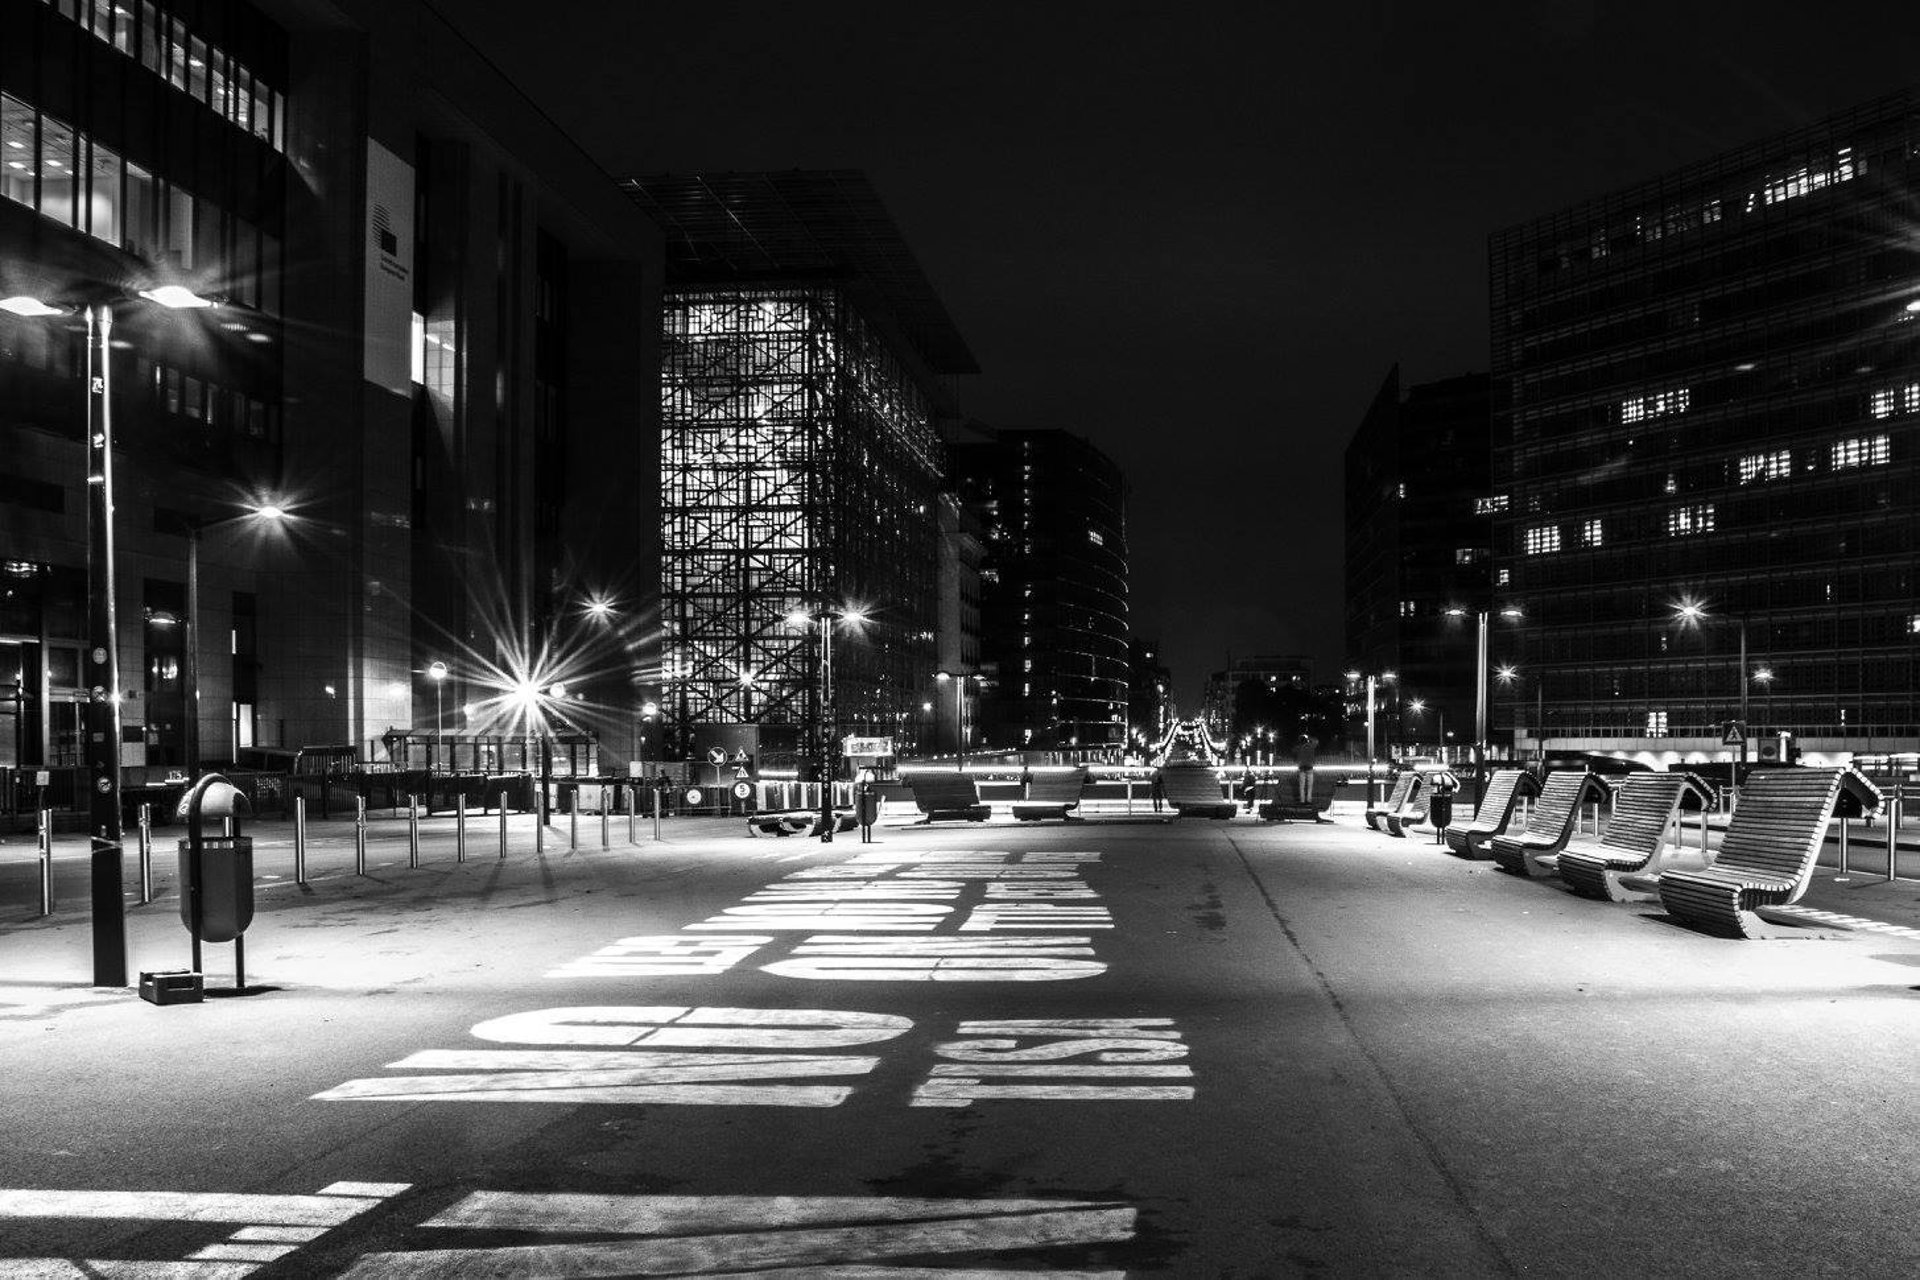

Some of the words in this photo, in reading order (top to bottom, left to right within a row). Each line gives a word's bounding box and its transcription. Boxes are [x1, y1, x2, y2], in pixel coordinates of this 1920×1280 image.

[741, 880, 967, 902] NO
[681, 902, 955, 931] NO
[957, 903, 1116, 932] TTIP
[758, 936, 1110, 981] NO
[309, 1006, 915, 1107] NO
[909, 1018, 1196, 1107] TISA
